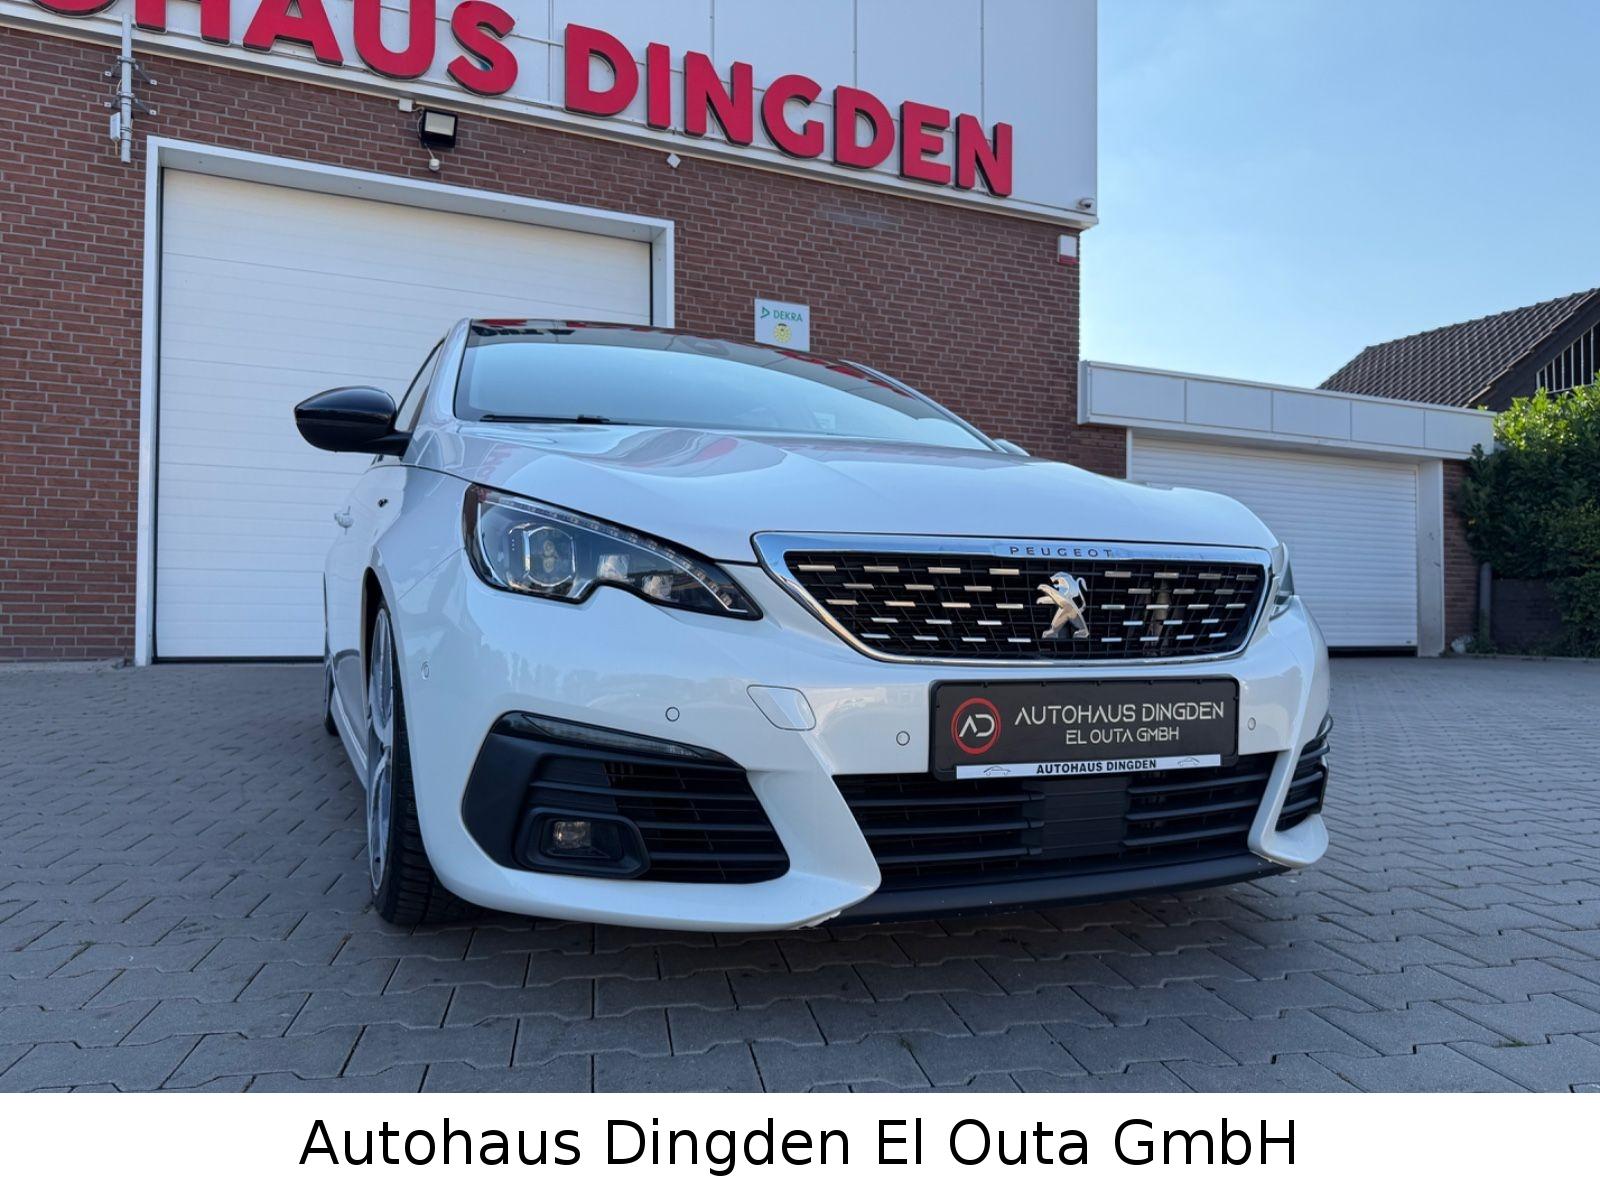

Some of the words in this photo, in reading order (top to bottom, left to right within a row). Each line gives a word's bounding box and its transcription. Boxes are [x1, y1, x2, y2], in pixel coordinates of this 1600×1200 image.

[565, 23, 1012, 197] DINGDEN
[773, 310, 803, 322] DEKRA
[1009, 546, 1113, 557] PEUGEOT
[1014, 704, 1136, 725] AUTOHAUS
[1142, 701, 1224, 722] DINGDEN
[959, 714, 996, 738] AD
[1066, 729, 1088, 745] EL
[1090, 728, 1134, 744] OUTA
[1136, 726, 1180, 742] GMBH
[1036, 763, 1103, 774] AUTOHAUS
[1106, 760, 1157, 771] DINGDEN
